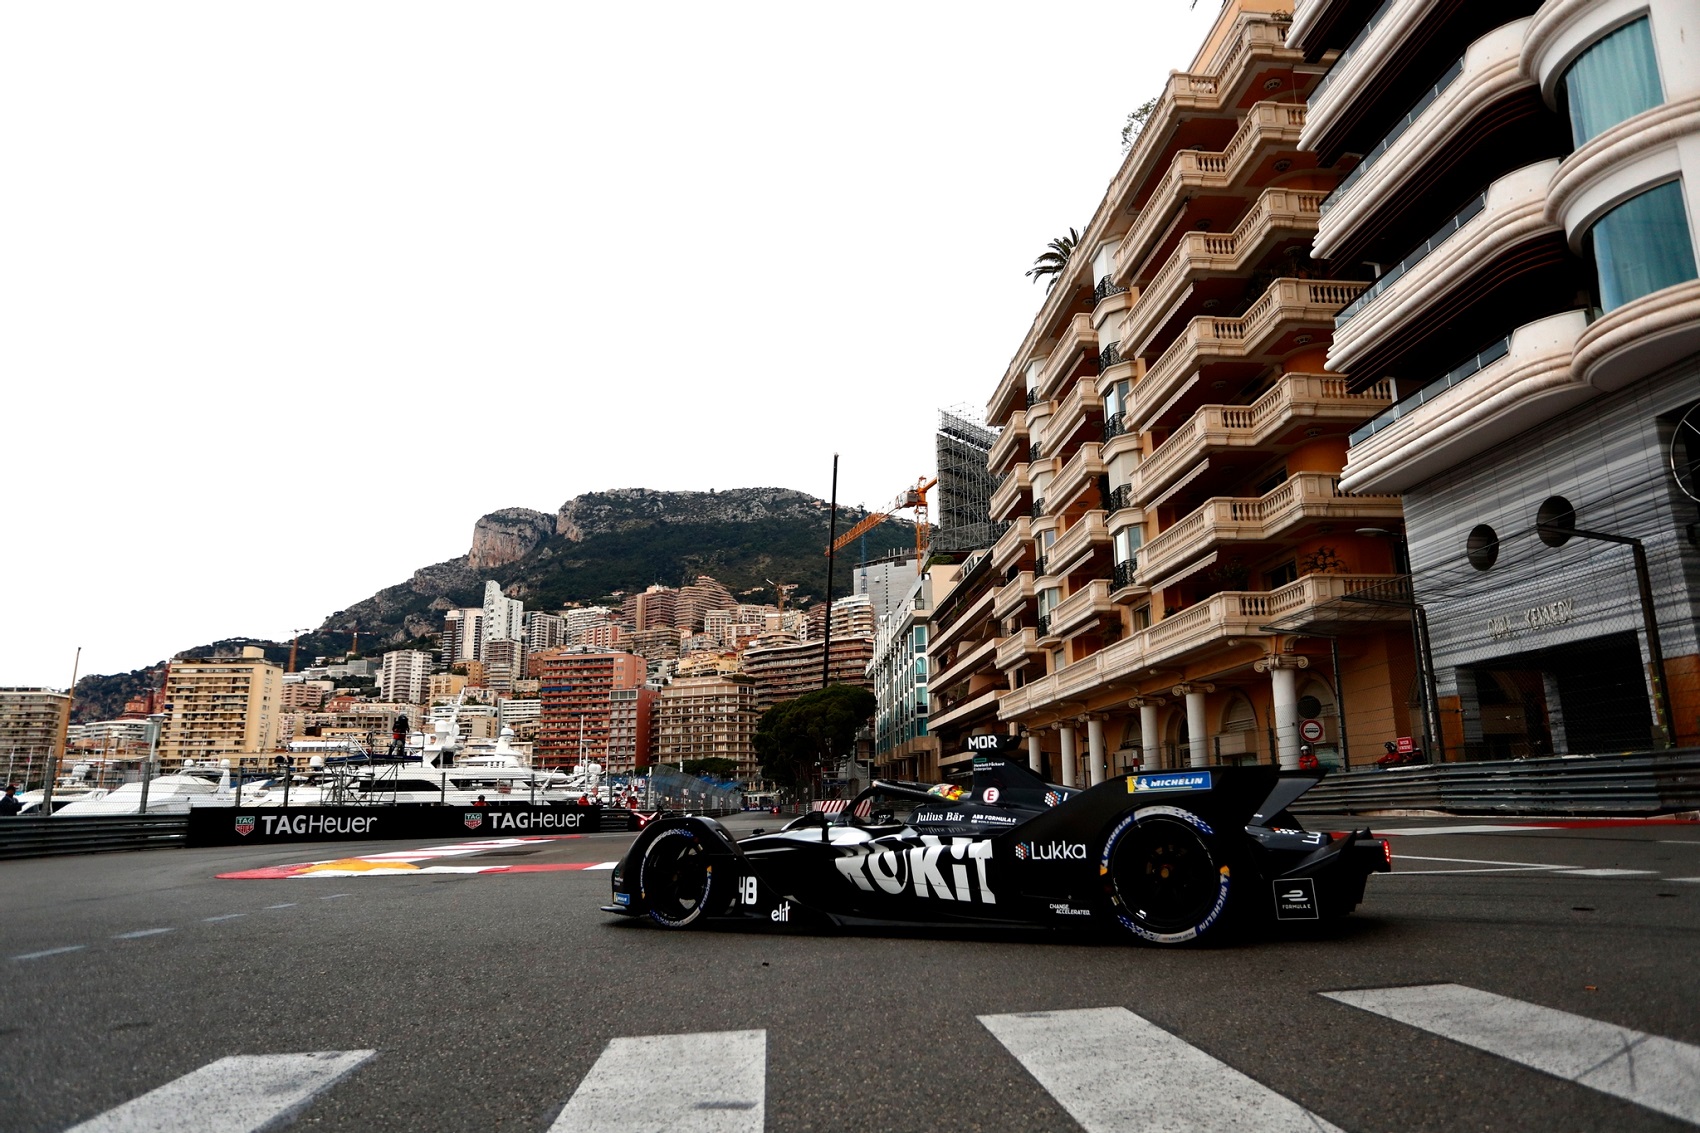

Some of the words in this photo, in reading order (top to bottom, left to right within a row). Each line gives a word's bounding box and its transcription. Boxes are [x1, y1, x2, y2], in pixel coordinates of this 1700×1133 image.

[968, 735, 997, 749] MOR
[1151, 778, 1203, 787] MICHELIN
[987, 790, 994, 800] E
[916, 812, 943, 823] Julius
[946, 811, 964, 821] Bär
[1103, 815, 1132, 857] MICHELIN
[1031, 840, 1086, 859] Lukka
[739, 876, 757, 904] 48
[1199, 885, 1228, 932] MICHELIN
